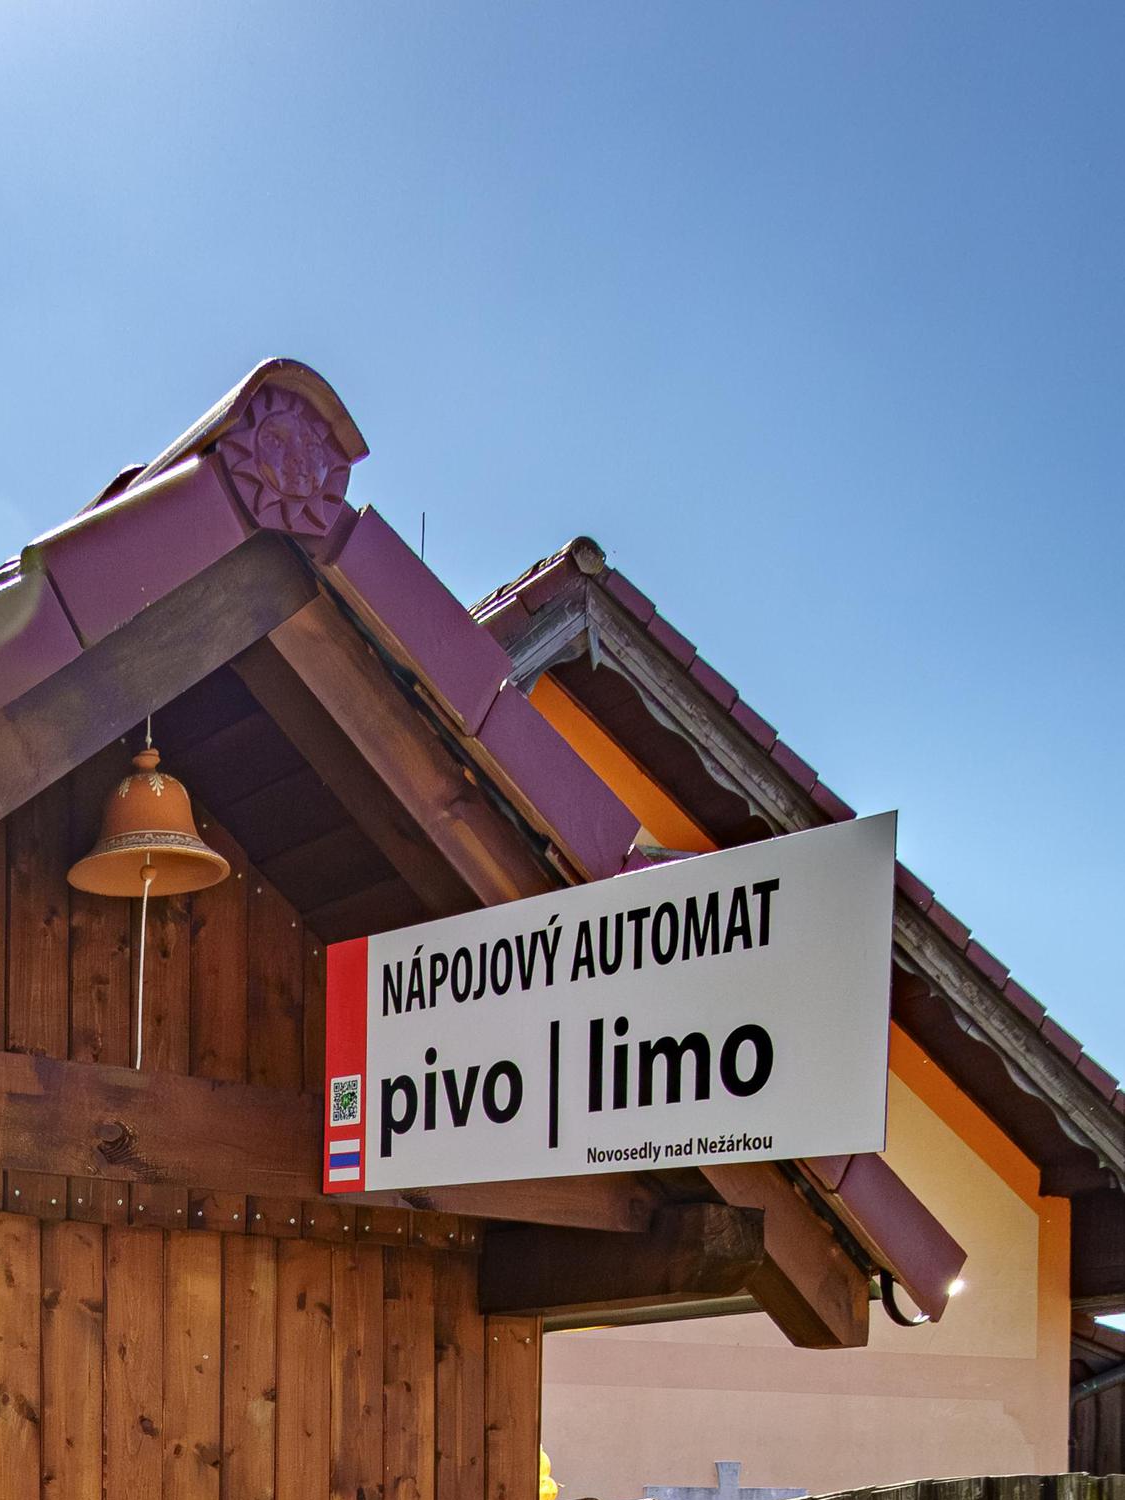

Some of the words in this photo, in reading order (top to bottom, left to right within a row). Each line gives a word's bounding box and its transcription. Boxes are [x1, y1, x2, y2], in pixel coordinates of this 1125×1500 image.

[382, 914, 563, 1017] NÁPOJOVÝ
[569, 878, 780, 982] AUTOMAT
[380, 1047, 523, 1157] pivo
[588, 1015, 775, 1113] limo
[586, 1139, 662, 1164] Novosedly
[664, 1137, 693, 1158] nad
[696, 1133, 774, 1156] Nežárkou
